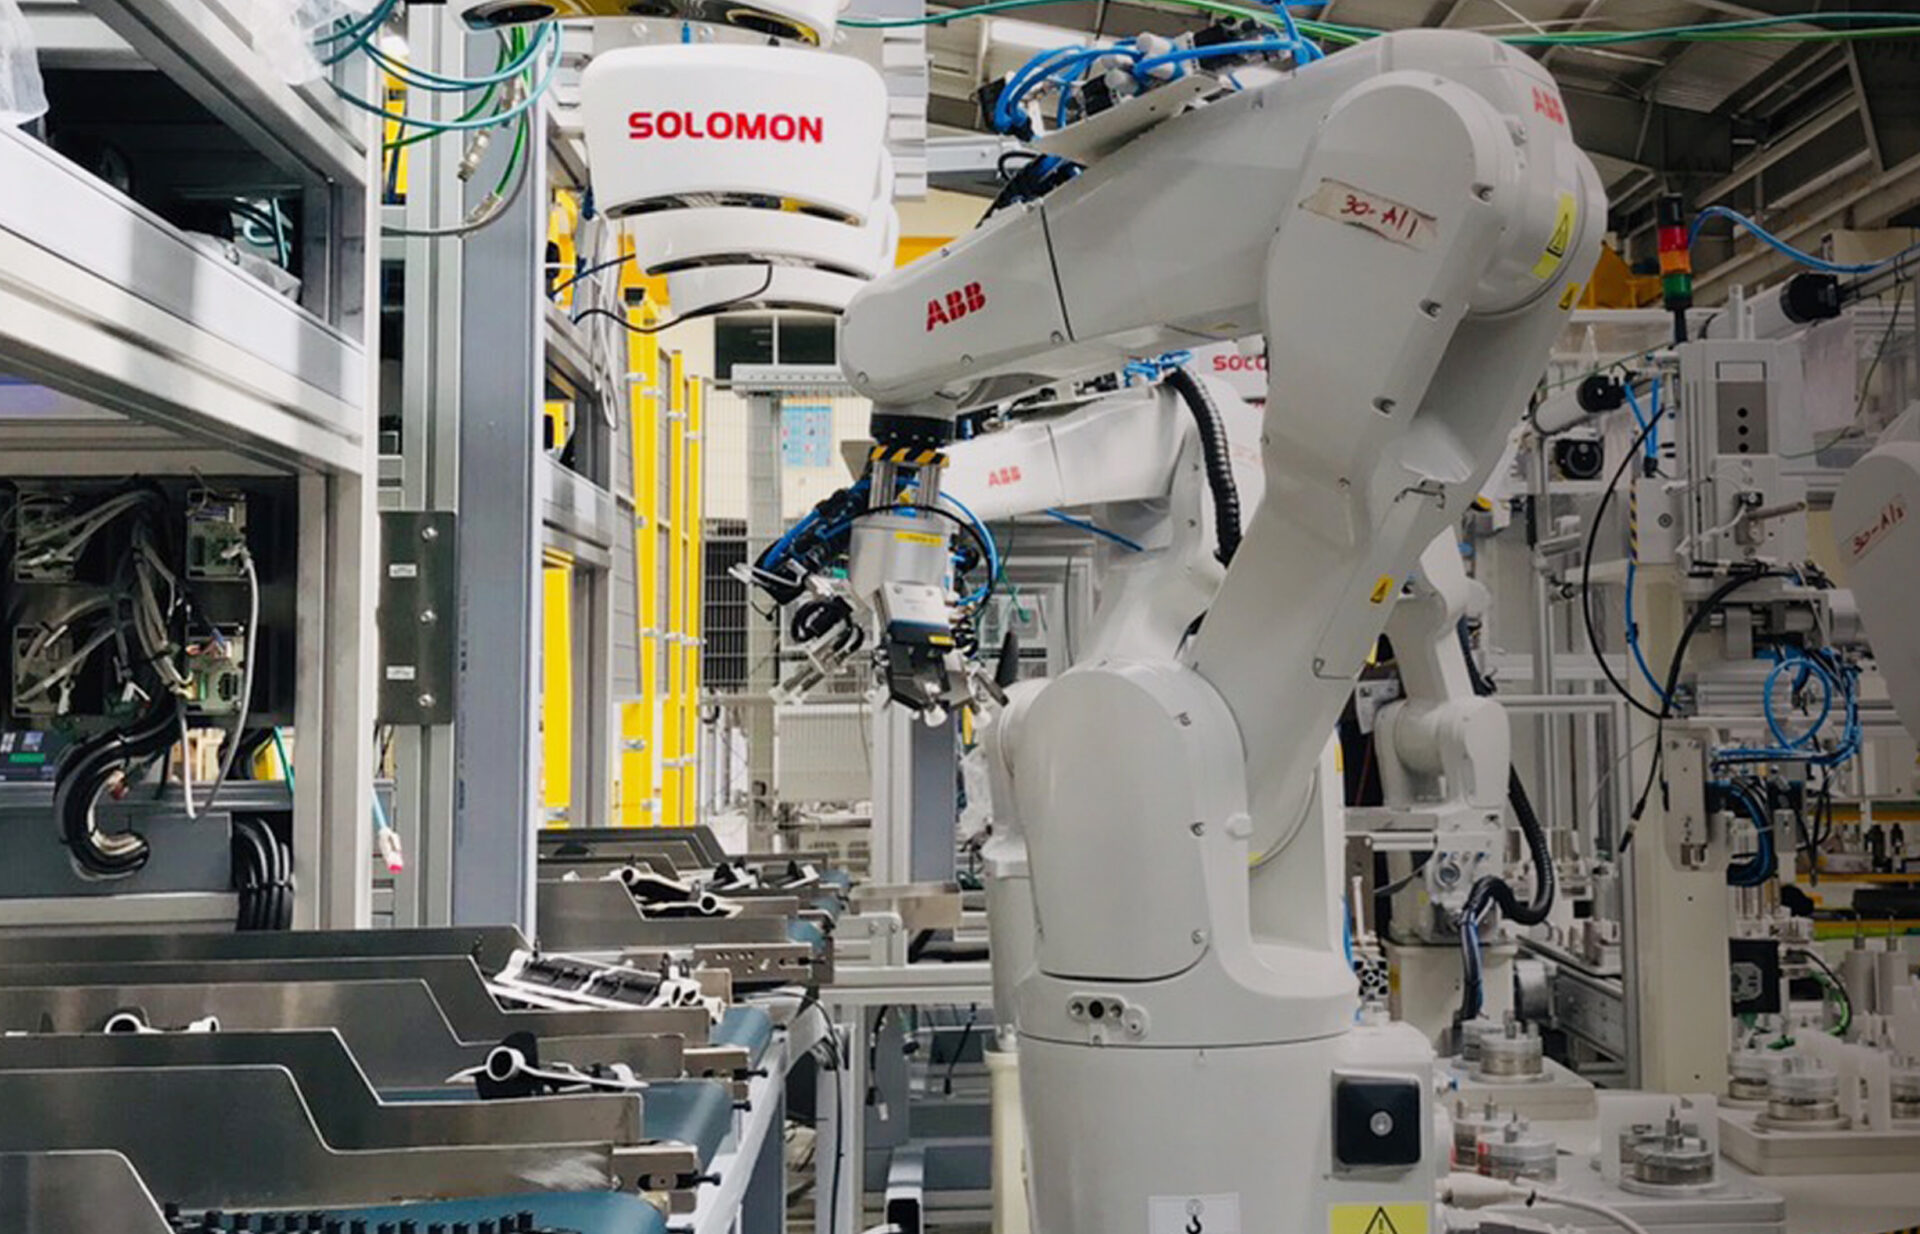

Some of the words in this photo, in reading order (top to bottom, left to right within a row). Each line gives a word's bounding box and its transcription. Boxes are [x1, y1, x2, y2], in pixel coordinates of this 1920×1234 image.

[628, 111, 823, 143] SOLOMON
[926, 281, 986, 332] ABB
[988, 465, 1021, 488] ABB
